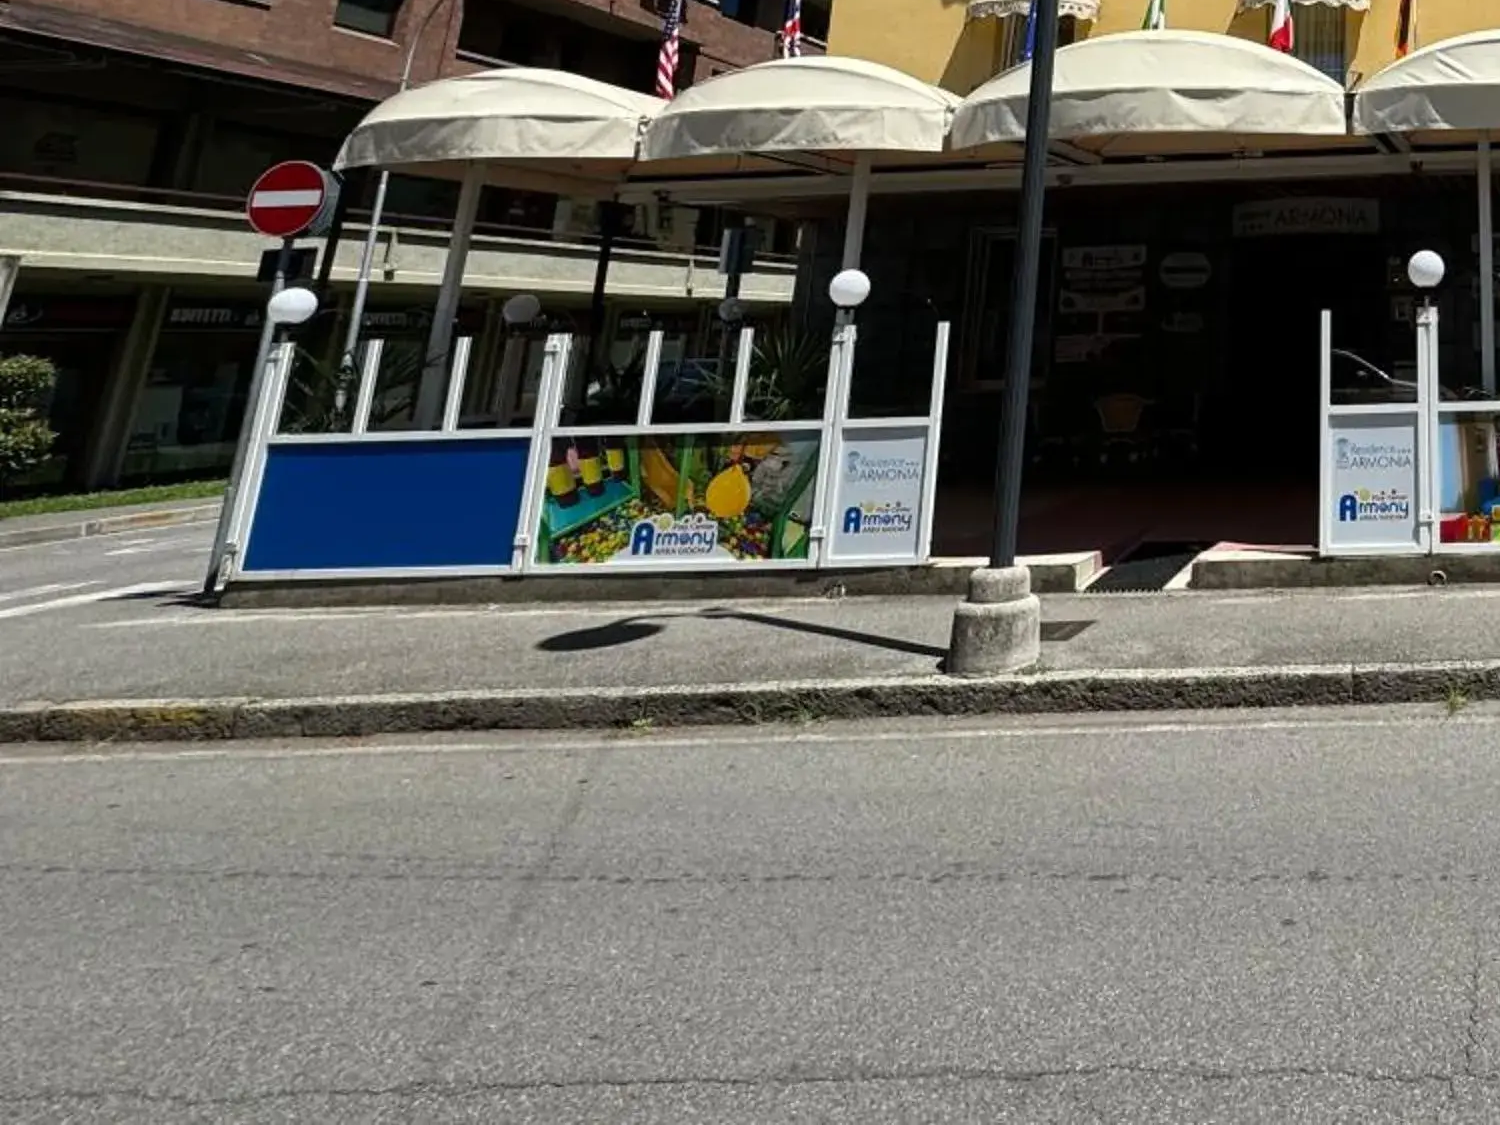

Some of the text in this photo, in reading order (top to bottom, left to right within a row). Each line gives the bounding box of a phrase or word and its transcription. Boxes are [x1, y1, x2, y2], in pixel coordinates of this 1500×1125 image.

[859, 467, 919, 481] ARMONIA
[1350, 455, 1411, 469] ARMONIA
[843, 506, 912, 533] Armony
[1339, 494, 1409, 521] Armony
[631, 521, 715, 556] Armony
